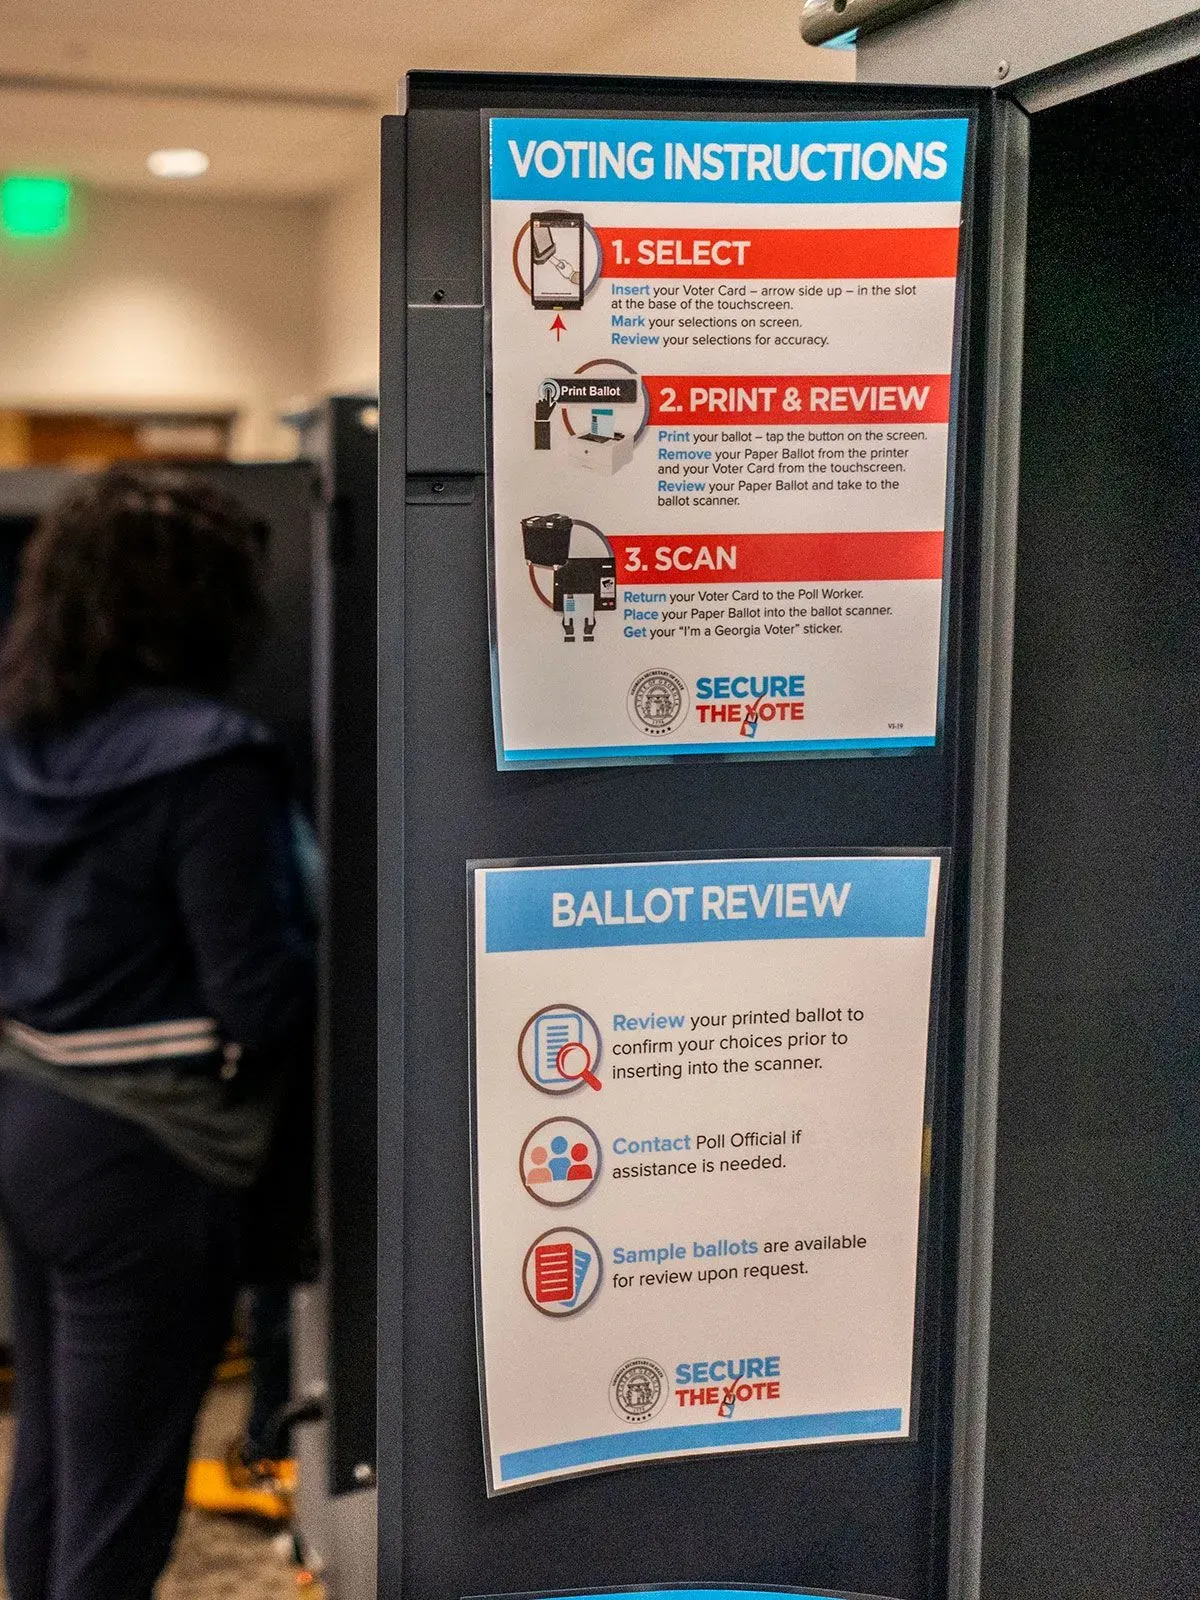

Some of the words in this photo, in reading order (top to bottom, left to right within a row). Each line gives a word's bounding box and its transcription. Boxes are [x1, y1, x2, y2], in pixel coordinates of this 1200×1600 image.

[508, 139, 654, 180] VOTING
[665, 141, 948, 182] INSTRUCTIONS
[612, 239, 630, 264] 1.
[638, 239, 751, 265] SELECT
[612, 284, 649, 296] Insert
[653, 287, 679, 299] your
[683, 285, 714, 297] Voter
[718, 285, 746, 297] Card
[761, 288, 795, 297] arrow
[799, 286, 823, 297] side
[827, 288, 842, 299] up
[858, 286, 867, 296] in
[872, 285, 890, 296] the
[895, 285, 916, 296] slot
[611, 299, 622, 309] at
[626, 298, 644, 309] the
[649, 298, 676, 310] base
[680, 298, 692, 309] of
[695, 298, 713, 309] the
[718, 298, 793, 310] touchscreen.
[612, 315, 645, 328] Mark
[649, 318, 674, 330] your
[679, 317, 737, 328] selections
[741, 319, 755, 328] on
[760, 319, 801, 328] screen.
[612, 332, 659, 345] Review
[663, 336, 689, 347] your
[693, 334, 751, 346] selections
[755, 334, 771, 346] for
[775, 336, 828, 348] accuracy.
[561, 386, 586, 396] Print
[590, 386, 620, 397] Ballot
[660, 387, 682, 412] 2.
[691, 387, 777, 412] PRINT
[782, 386, 802, 412] &
[810, 386, 930, 412] REVIEW
[659, 431, 690, 443] Print
[693, 433, 718, 446] your
[722, 431, 752, 442] ballot
[766, 431, 784, 444] tap
[787, 431, 804, 442] the
[809, 431, 844, 441] button
[848, 432, 862, 441] on
[865, 430, 883, 441] the
[887, 432, 927, 441] screen.
[658, 447, 711, 460] Remove
[715, 451, 740, 462] your
[745, 448, 778, 462] Paper
[782, 448, 814, 460] Ballot
[818, 448, 844, 459] from
[848, 447, 866, 458] the
[871, 447, 908, 460] printer
[658, 464, 679, 475] and
[683, 465, 709, 477] your
[712, 463, 743, 475] Voter
[747, 462, 774, 474] Card
[779, 462, 804, 474] from
[808, 463, 826, 474] the
[831, 462, 905, 473] touchscreen.
[658, 480, 705, 492] Review
[709, 482, 734, 494] your
[739, 480, 771, 493] Paper
[776, 480, 808, 491] Ballot
[812, 480, 833, 491] and
[837, 480, 862, 491] take
[866, 479, 877, 489] to
[881, 479, 899, 489] the
[658, 496, 689, 507] ballot
[693, 497, 740, 508] scanner.
[624, 547, 648, 572] 3.
[655, 546, 737, 571] SCAN
[624, 591, 666, 603] Return
[670, 593, 695, 605] your
[698, 591, 728, 602] Voter
[732, 589, 758, 602] Card
[763, 591, 773, 600] to
[777, 590, 794, 600] the
[799, 589, 818, 600] Poll
[822, 588, 863, 599] Worker.
[624, 608, 659, 621] Place
[662, 610, 687, 623] your
[691, 608, 724, 621] Paper
[729, 607, 760, 619] Ballot
[764, 607, 785, 617] into
[789, 606, 807, 617] the
[811, 606, 842, 617] ballot
[846, 607, 892, 616] scanner.
[624, 625, 647, 638] Get
[650, 628, 675, 640] your
[704, 627, 711, 636] a
[715, 624, 760, 638] Georgia
[804, 623, 842, 634] sticker.
[696, 675, 805, 699] SECURE
[696, 704, 741, 722] THE
[553, 887, 693, 926] BALLOT
[702, 882, 852, 920] REVIEW
[614, 1013, 684, 1031] Review
[691, 1015, 727, 1032] your
[733, 1008, 789, 1029] printed
[796, 1007, 842, 1023] ballot
[847, 1008, 864, 1021] to
[613, 1038, 672, 1055] confirm
[678, 1039, 714, 1056] your
[720, 1034, 782, 1050] choices
[788, 1032, 826, 1050] prior
[832, 1032, 848, 1046] to
[613, 1063, 682, 1080] inserting
[689, 1060, 718, 1075] into
[723, 1059, 749, 1074] the
[755, 1058, 822, 1072] scanner.
[613, 1135, 690, 1155] Contact
[697, 1134, 724, 1150] Poll
[731, 1130, 785, 1147] Official
[792, 1129, 802, 1145] if
[613, 1162, 696, 1179] assistance
[703, 1159, 714, 1173] is
[720, 1154, 785, 1171] needed.
[613, 1243, 686, 1265] Sample
[694, 1239, 758, 1258] ballots
[764, 1241, 789, 1254] are
[795, 1234, 866, 1251] available
[613, 1273, 634, 1288] for
[640, 1269, 692, 1286] review
[698, 1267, 737, 1284] upon
[744, 1260, 808, 1279] request.
[675, 1356, 780, 1384] SECURE
[675, 1387, 719, 1407] THE
